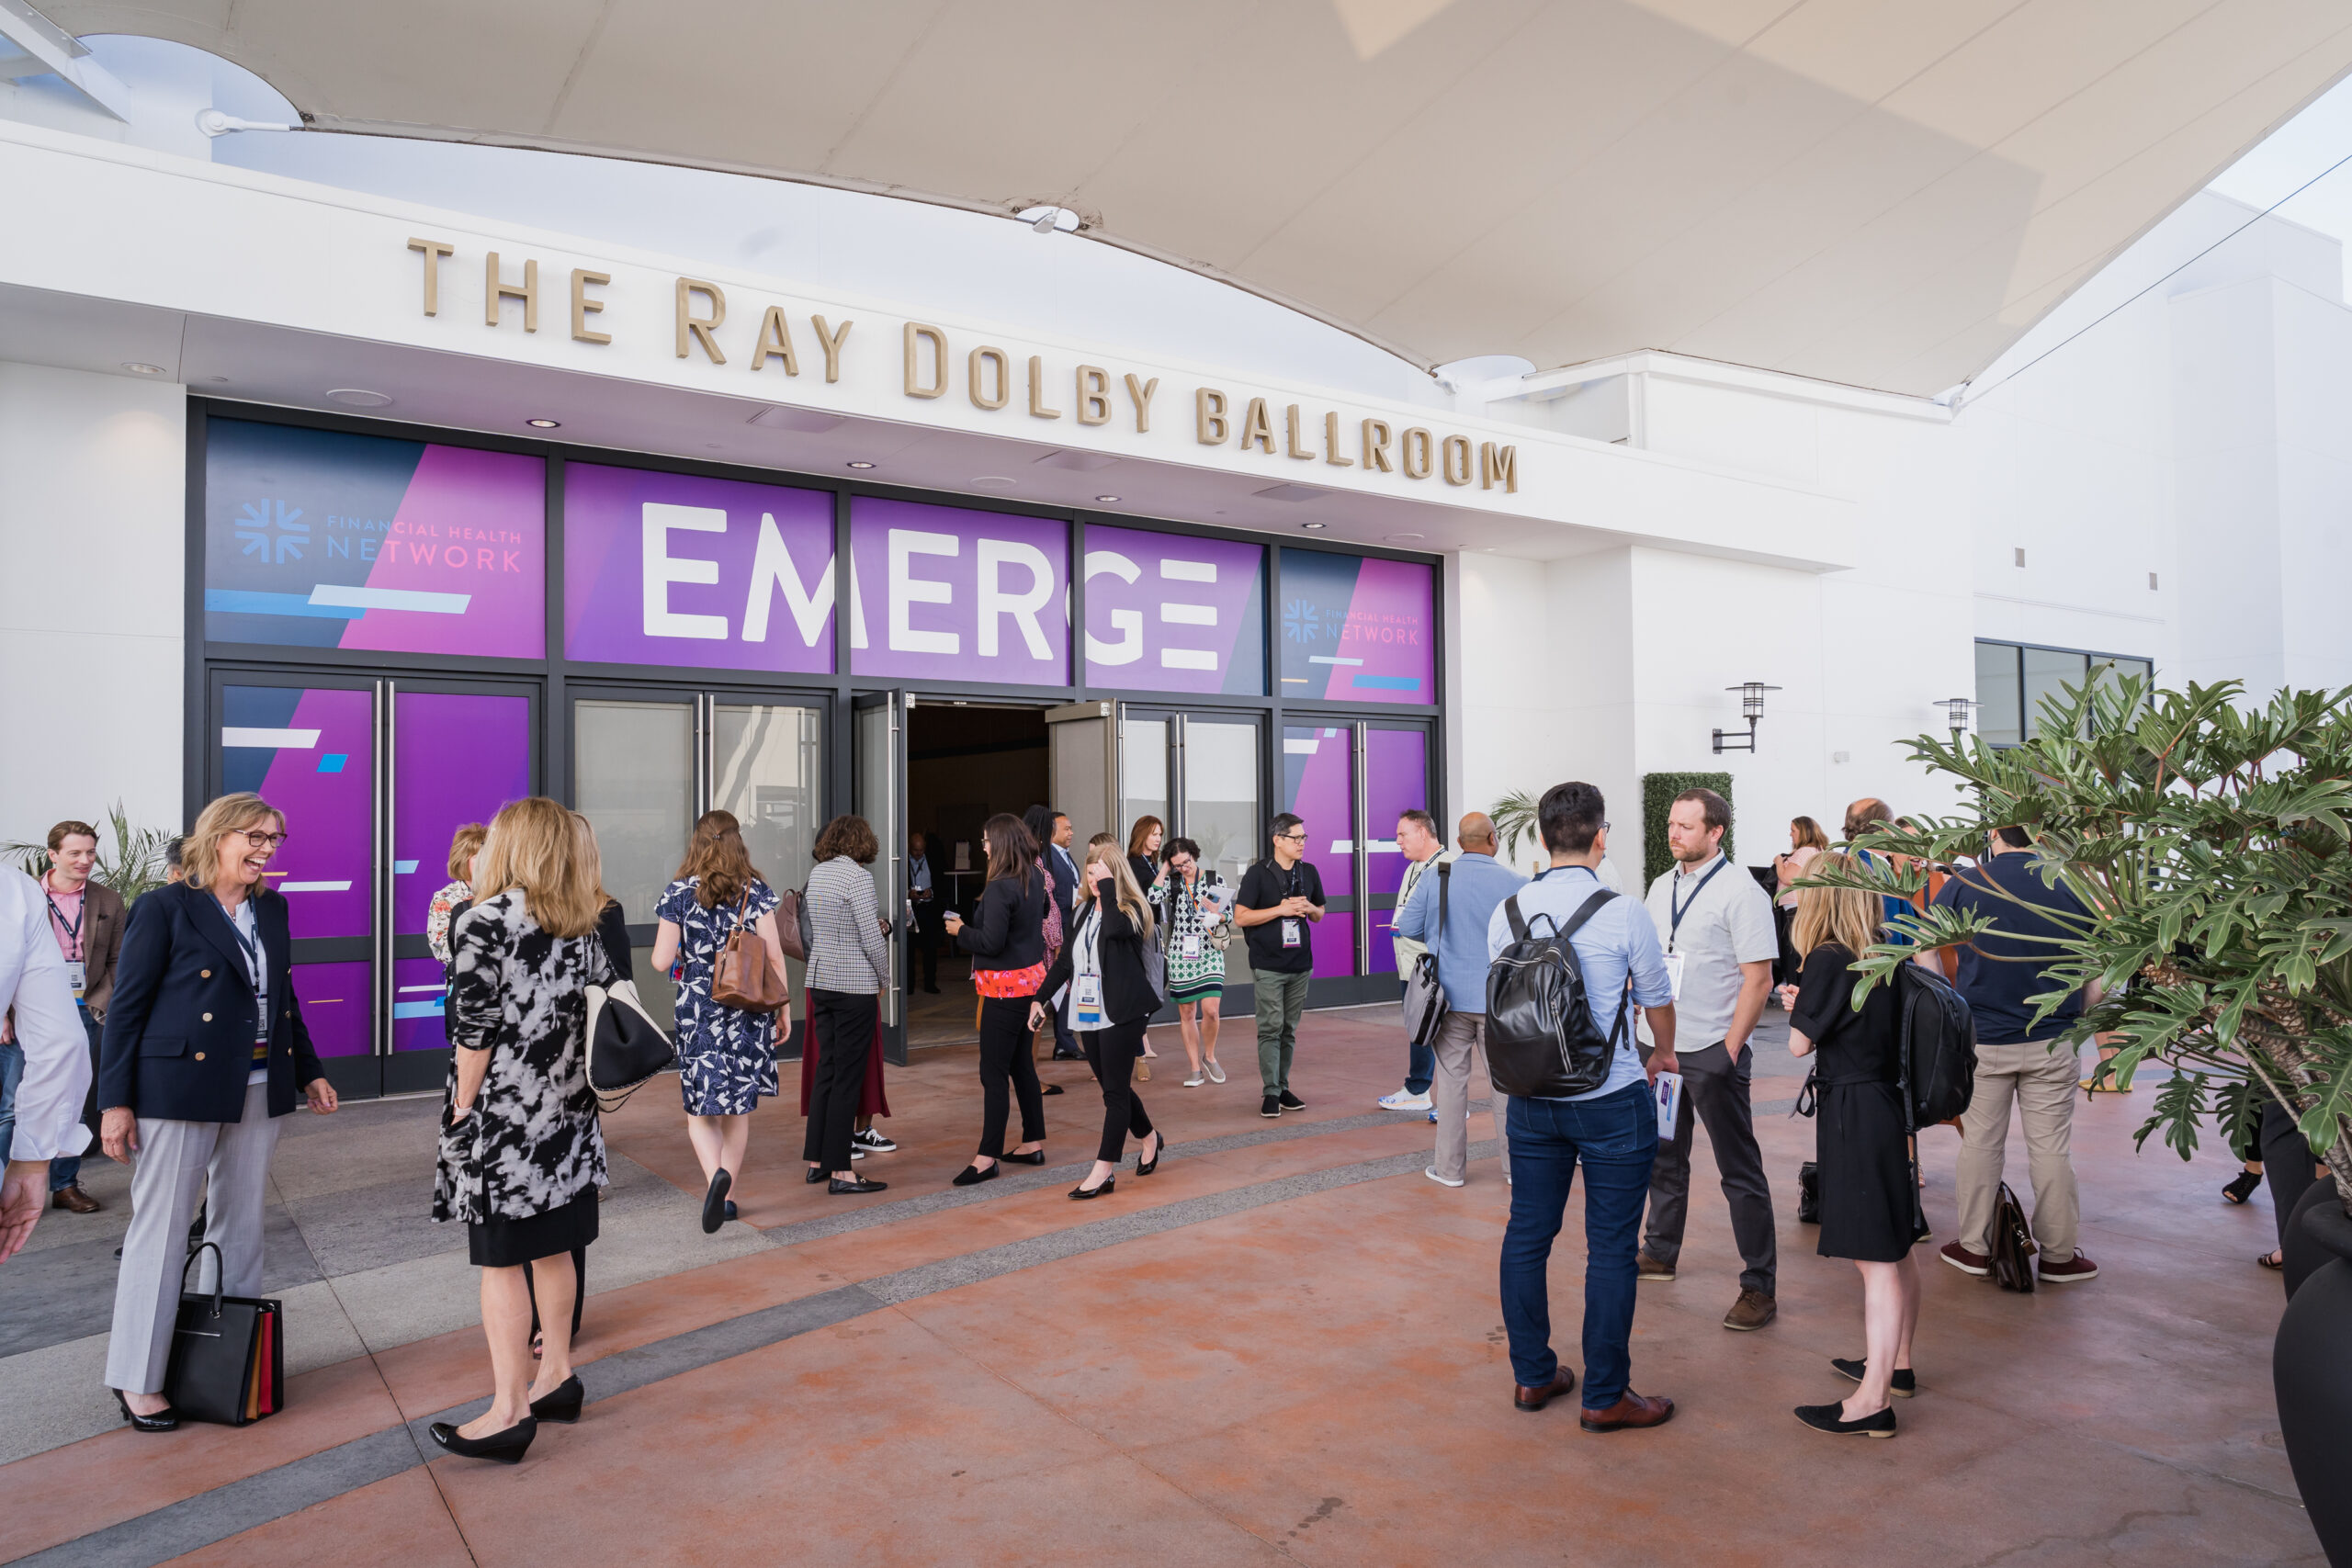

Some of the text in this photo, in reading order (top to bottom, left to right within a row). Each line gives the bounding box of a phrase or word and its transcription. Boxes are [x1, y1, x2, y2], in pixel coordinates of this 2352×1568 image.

[406, 236, 1518, 494] THE RAY DOLBY BALLROOM
[326, 514, 522, 545] FINANCIAL HEALTH
[327, 536, 521, 573] NETWORK
[642, 502, 1218, 671] EMERGE
[1326, 609, 1419, 626] FINANCIAL HEALTH
[1326, 624, 1419, 646] NETWORK
